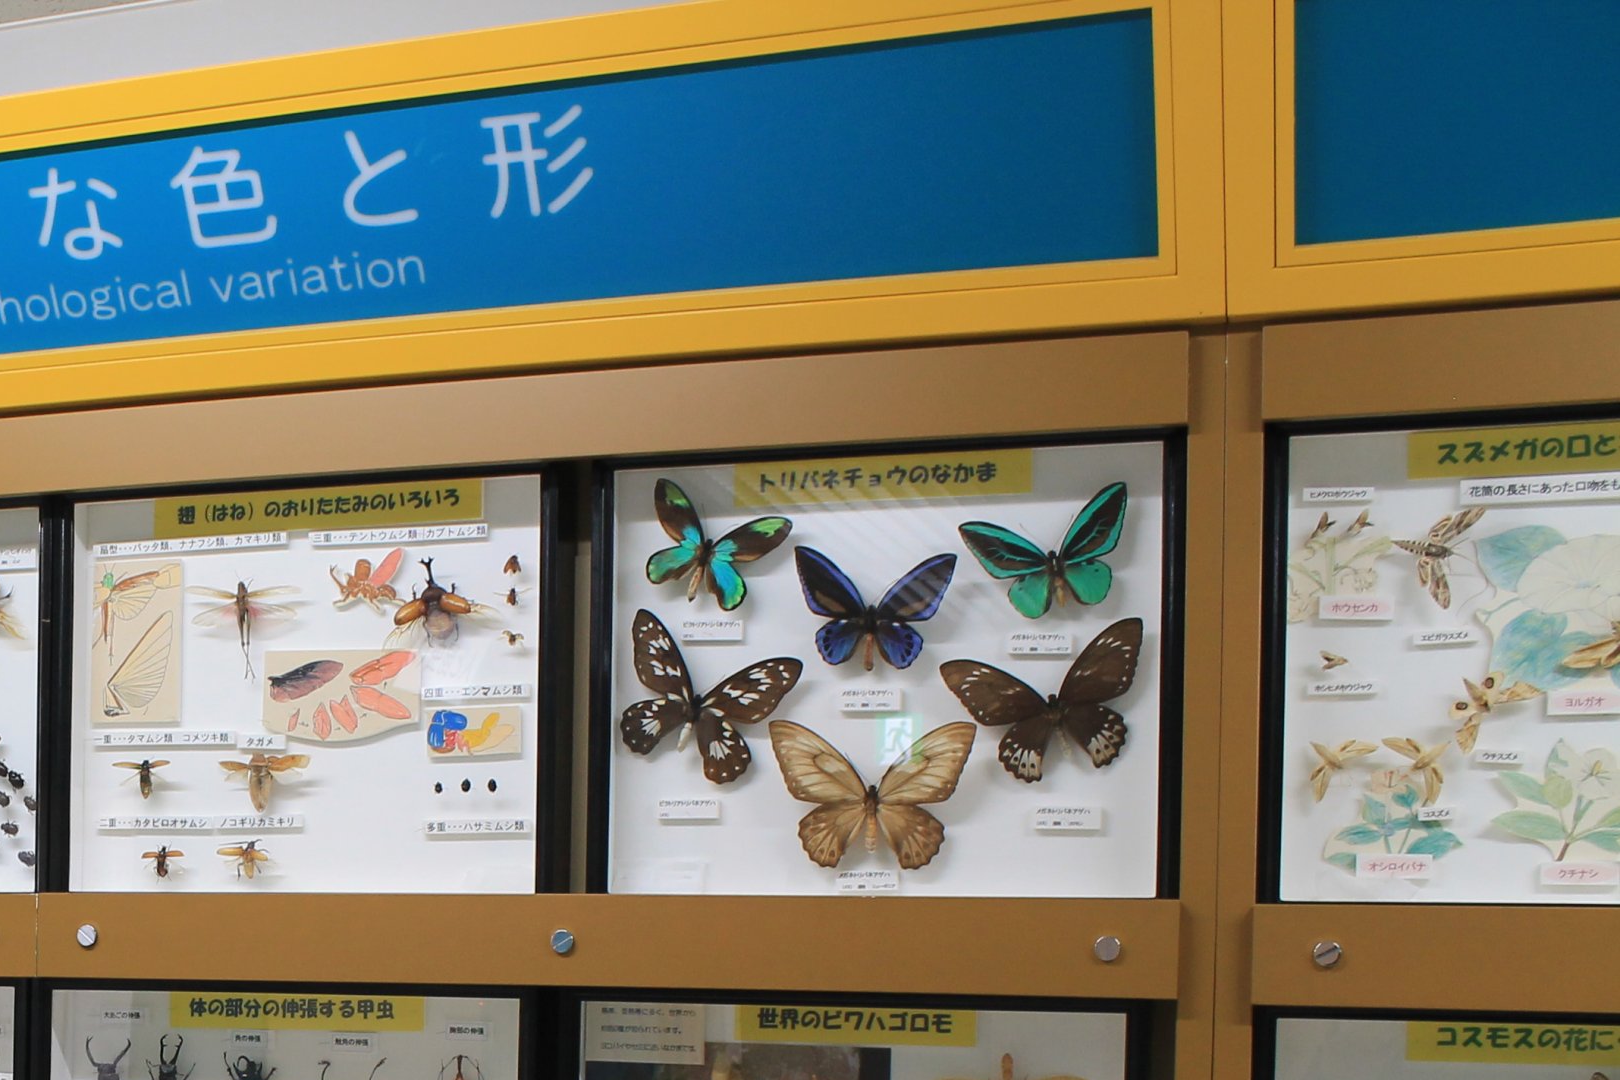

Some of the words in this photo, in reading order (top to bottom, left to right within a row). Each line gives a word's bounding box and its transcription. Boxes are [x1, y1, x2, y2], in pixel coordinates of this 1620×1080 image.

[209, 250, 425, 305] variation
[1437, 435, 1620, 465] スズメガの口と
[759, 461, 996, 492] トリバネチョウのなかま
[426, 525, 486, 538] カブトムシ類
[1332, 604, 1378, 612] ホウセンカ
[1421, 631, 1469, 642] エビガラスズメ
[1565, 697, 1605, 707] ヨルガオ
[182, 733, 228, 744] コメツキ類
[246, 737, 274, 747] タガメ
[1482, 752, 1518, 760] ウチスズメ
[1423, 809, 1450, 817] コスズメ
[220, 816, 295, 828] ノコギリカミキリ
[1369, 862, 1426, 871] オシロイバナ
[1558, 869, 1598, 879] クチナシ
[189, 999, 395, 1019] 体の部分の伸張する甲虫
[758, 1008, 953, 1033] 世界のビワハゴロモ
[1436, 1027, 1620, 1051] コスモスの花に
